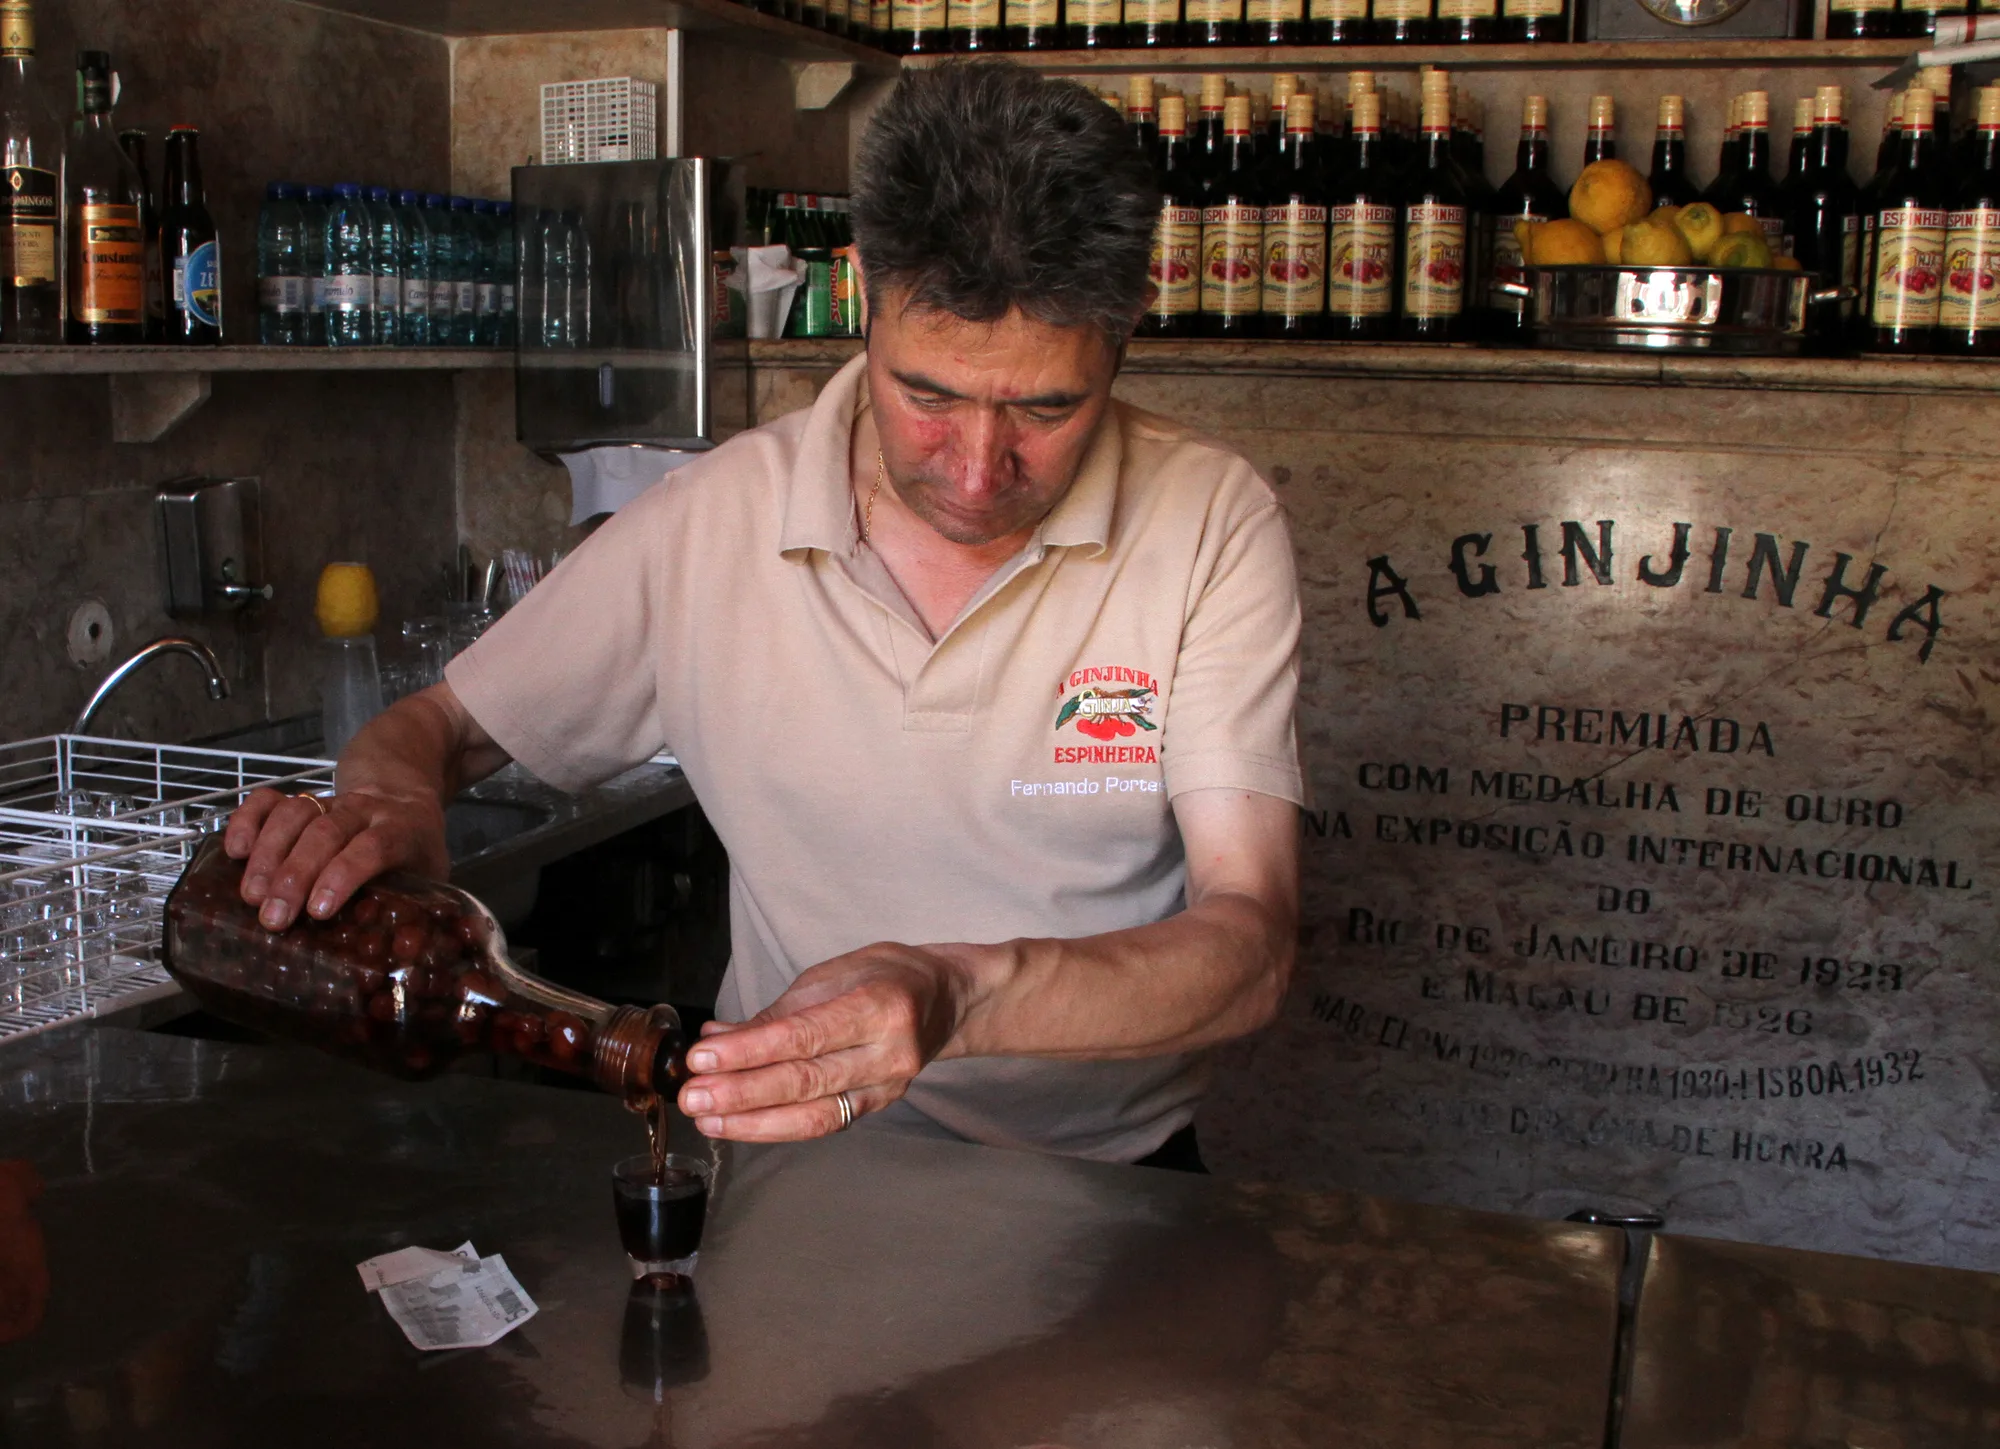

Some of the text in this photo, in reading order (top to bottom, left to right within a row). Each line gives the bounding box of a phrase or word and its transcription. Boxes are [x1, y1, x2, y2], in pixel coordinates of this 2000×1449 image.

[829, 259, 843, 326] SUMOL
[1365, 519, 1946, 664] A GINJINHA
[1069, 666, 1159, 697] GINJINHA
[1077, 689, 1132, 718] GINJA
[1500, 703, 1776, 758] PREMIADA
[1054, 746, 1157, 764] ESPINHEIRA
[1011, 778, 1099, 796] Fernando
[1358, 761, 1903, 829] COM MEDALHA DE OURO
[1303, 810, 1353, 840] NA
[1626, 834, 1973, 890] INTERNACIONAL
[1597, 885, 1651, 914] DO
[1436, 923, 1491, 954] DE
[1513, 922, 1699, 973] JANEIRO
[1722, 949, 1777, 980] DE
[1633, 993, 1689, 1027] DE
[1672, 1123, 1718, 1157] DE
[1732, 1130, 1849, 1171] HONRA
